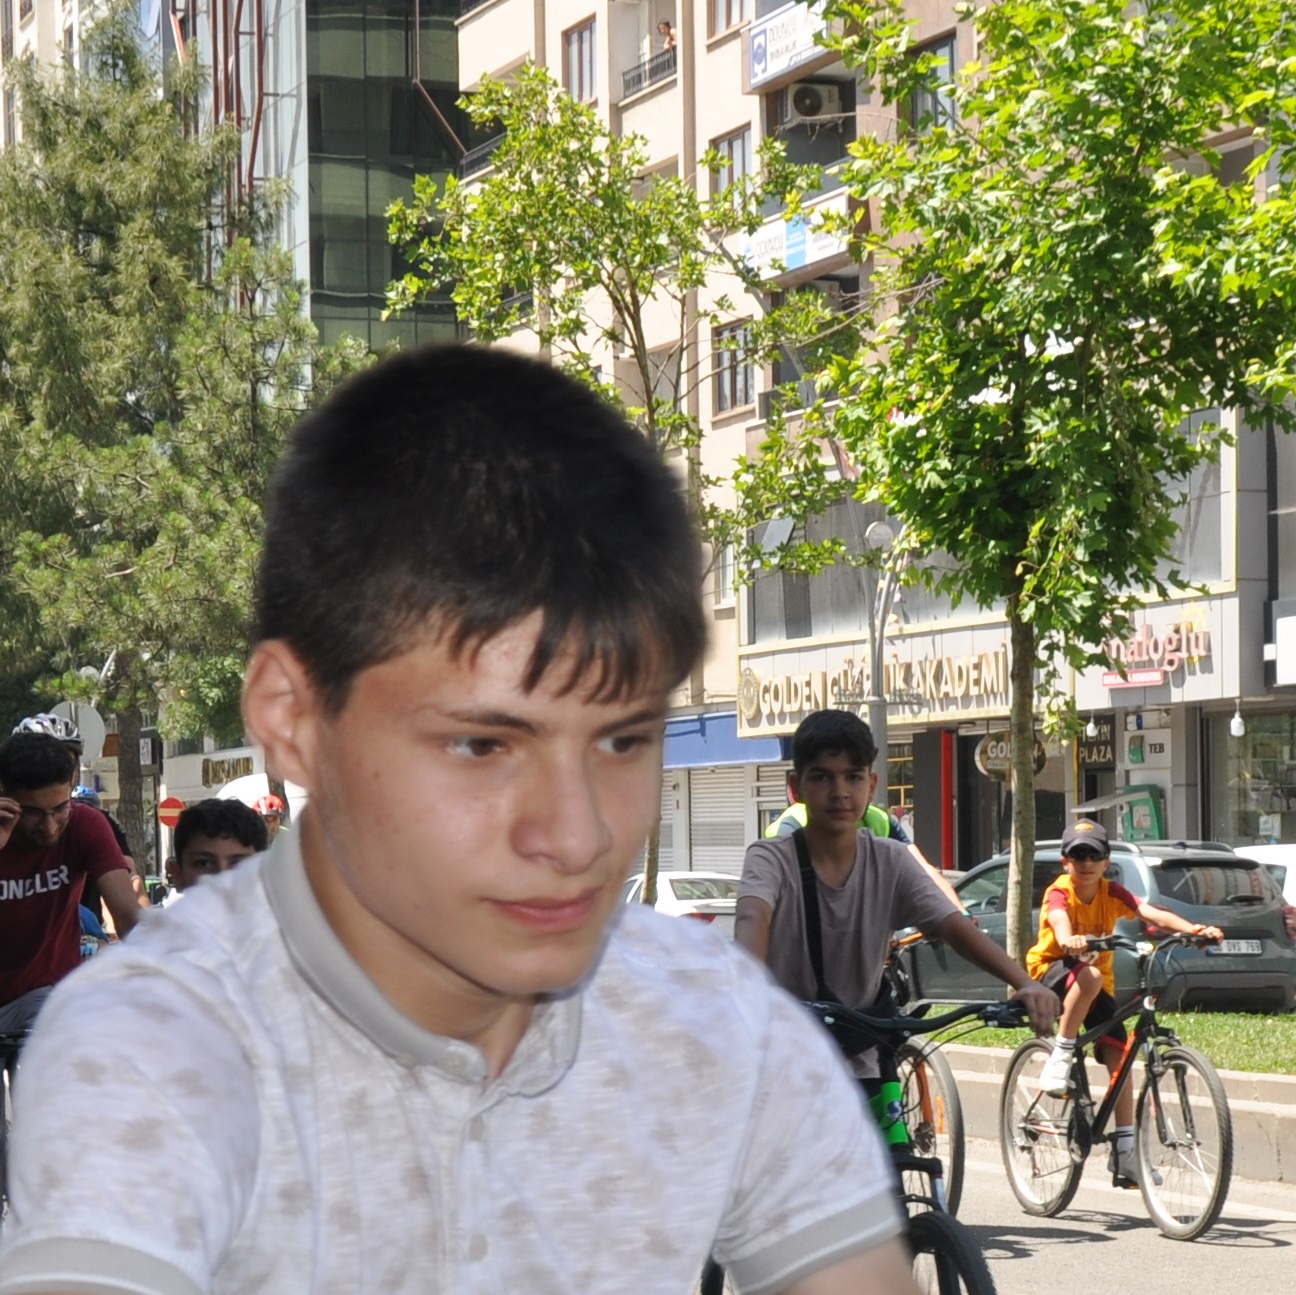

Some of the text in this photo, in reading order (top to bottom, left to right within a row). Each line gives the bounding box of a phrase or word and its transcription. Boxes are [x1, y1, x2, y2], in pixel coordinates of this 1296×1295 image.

[759, 670, 827, 716] GOLDEN
[1079, 746, 1113, 763] PLAZA
[1149, 743, 1165, 754] TEB
